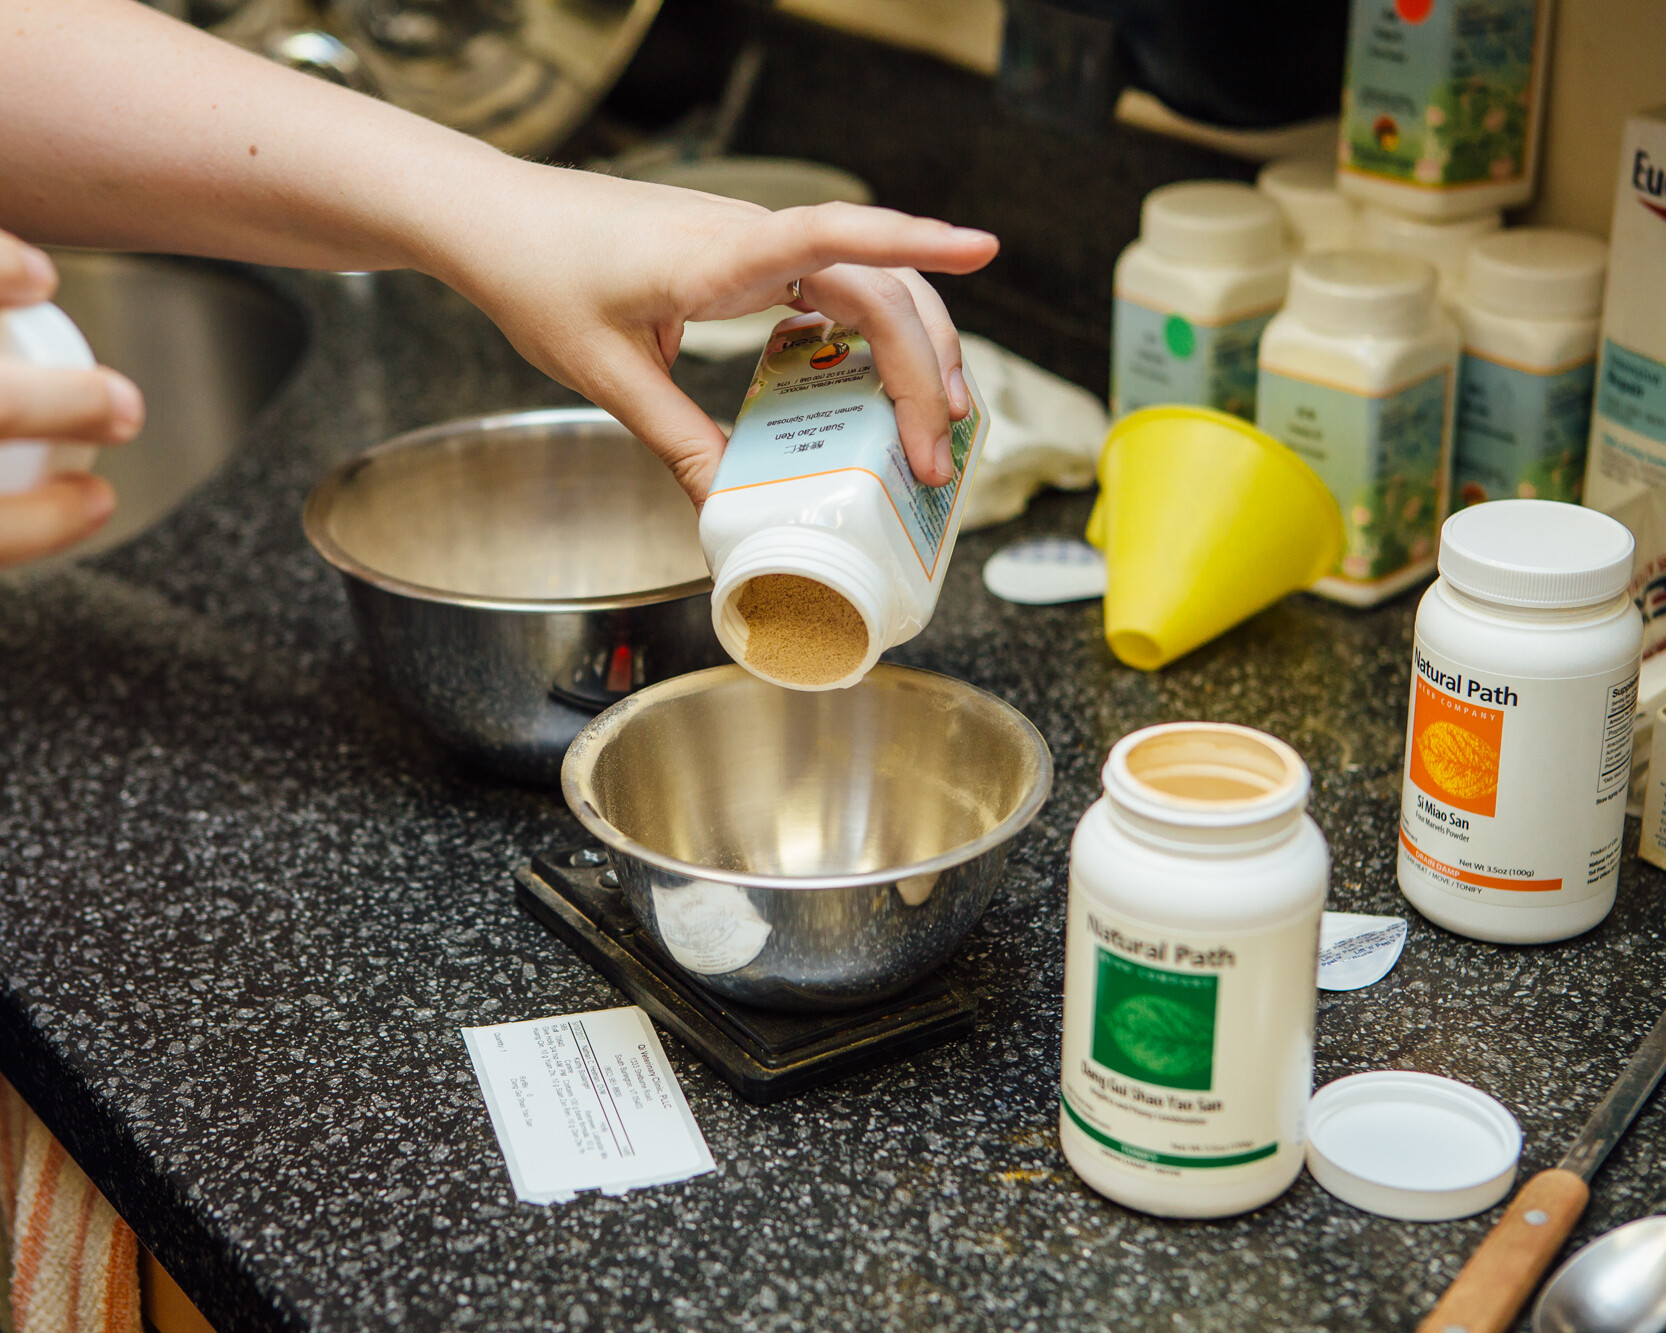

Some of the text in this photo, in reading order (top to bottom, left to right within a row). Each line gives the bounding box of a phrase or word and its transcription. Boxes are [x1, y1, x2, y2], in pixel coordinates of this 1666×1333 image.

[1633, 148, 1666, 199] Eu
[780, 375, 864, 395] PREMIUM HERBAL PRODUCT
[767, 404, 864, 427] Semen Ziziphi Spinosae
[775, 422, 845, 440] Suan Zao Ren
[1415, 646, 1518, 706] Natural Path
[1441, 698, 1496, 721] COMPANY
[1417, 794, 1424, 810] Si
[1425, 800, 1447, 822] Miao
[1449, 812, 1470, 831] San
[1426, 817, 1444, 834] Marvels
[1446, 827, 1470, 843] Powder
[1416, 850, 1460, 878] DRAIN DAMP
[1459, 858, 1535, 878] Net Wt 3.5oz (100g)
[1416, 861, 1428, 874] HEAT
[1432, 872, 1450, 886] MOVE
[1456, 882, 1482, 894] TONIFY
[1087, 912, 1168, 962] Natural
[1174, 942, 1236, 968] Path
[614, 1054, 625, 1066] South
[630, 1057, 640, 1068] 1333
[634, 1068, 647, 1089] Shelburne
[641, 1050, 656, 1076] Veterinary
[659, 1094, 672, 1109] PLLC
[1081, 1059, 1106, 1088] Dang
[1107, 1078, 1128, 1097] Gui
[1132, 1088, 1163, 1109] Shao
[1167, 1096, 1193, 1112] Yao
[1196, 1099, 1224, 1112] San
